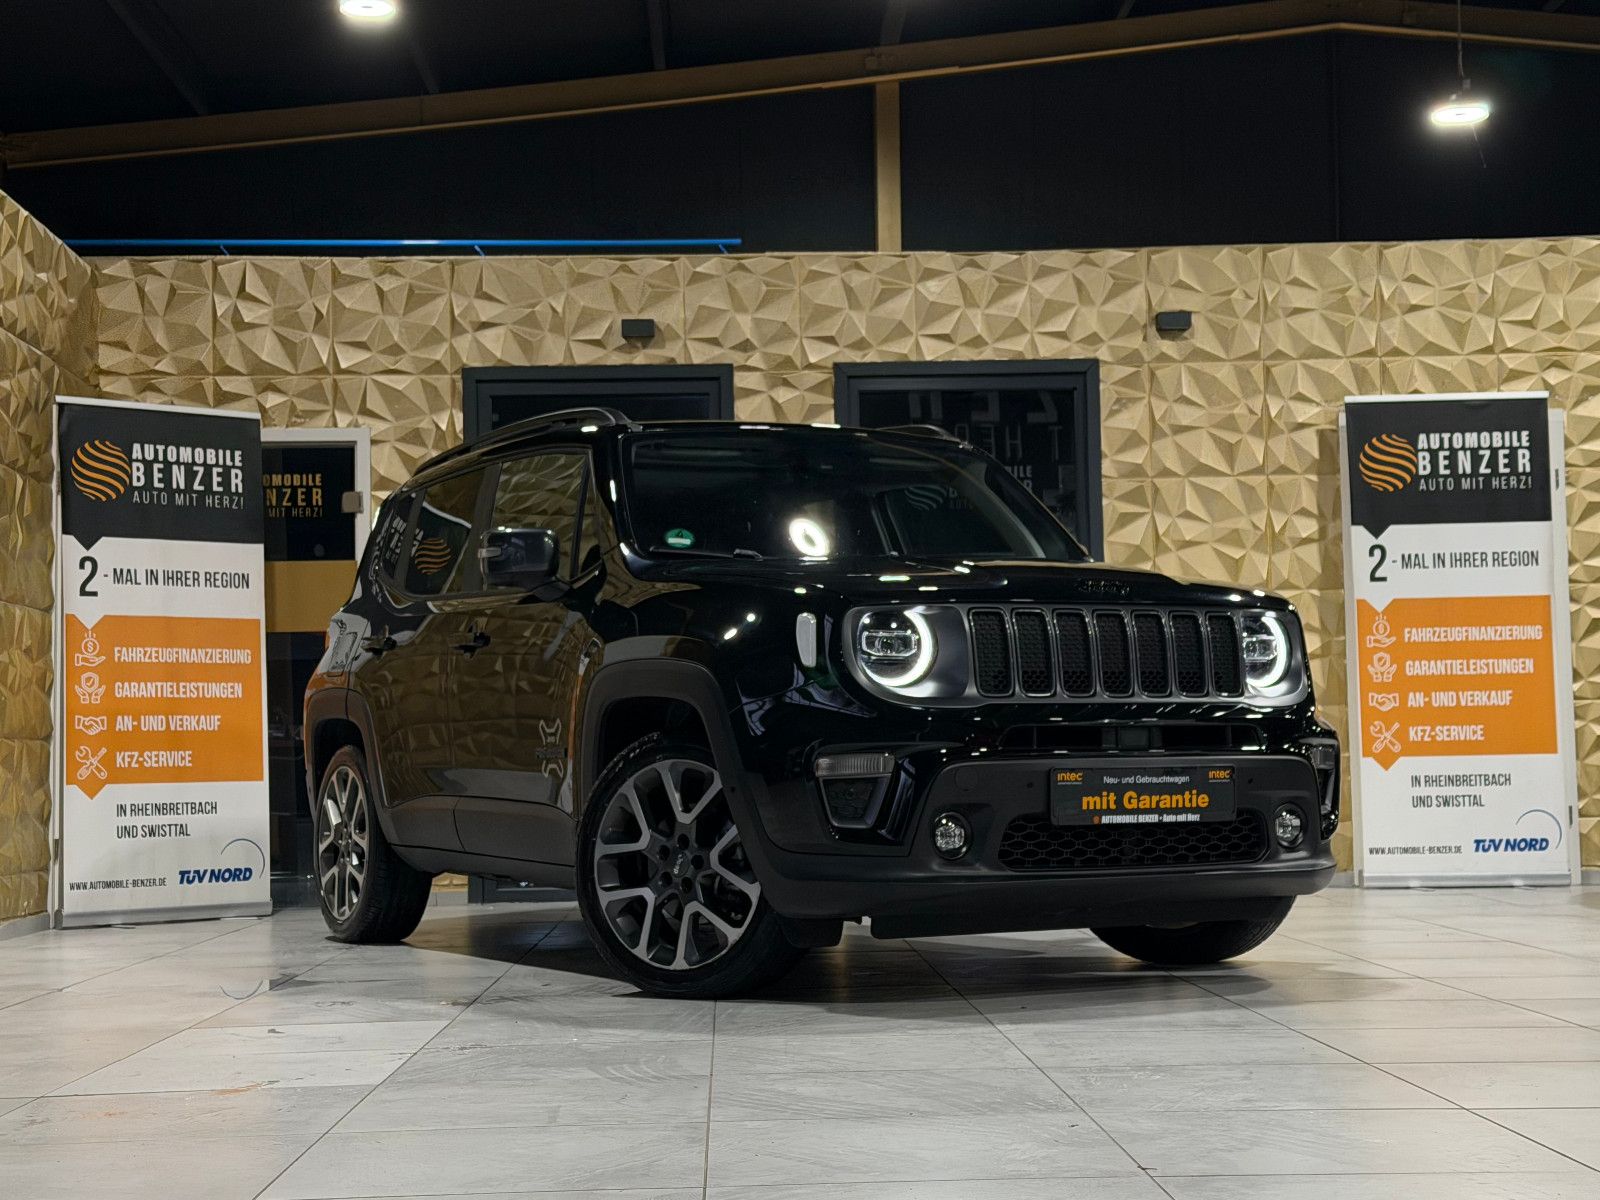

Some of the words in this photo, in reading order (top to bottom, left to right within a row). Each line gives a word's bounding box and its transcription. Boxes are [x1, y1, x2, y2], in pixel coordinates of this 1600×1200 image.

[1417, 430, 1530, 450] AUTOMOBILE
[132, 442, 243, 467] AUTOMOBILE
[1418, 449, 1531, 476] BENZER
[132, 462, 243, 494] BENZER
[1419, 477, 1454, 491] AUTO
[1461, 476, 1485, 490] MIT
[1492, 475, 1532, 490] HERZ!
[133, 492, 168, 506] AUTO
[175, 494, 197, 507] MIT
[206, 495, 244, 509] HERZ!
[1401, 553, 1429, 570] MAL
[1432, 552, 1446, 569] IN
[1450, 552, 1488, 568] IHRER
[1492, 550, 1539, 568] REGION
[112, 567, 142, 586] MAL
[145, 569, 159, 587] IN
[163, 570, 200, 588] IHRER
[204, 571, 250, 589] REGION
[1404, 625, 1543, 643] FAHRZEUGFINANZIERUNG
[114, 646, 252, 665] FAHRZEUGFINANZIERUNG
[1405, 658, 1534, 676] GARANTIELEISTUNGEN
[114, 681, 242, 699] GARANTIELEISTUNGEN
[1407, 691, 1429, 708] AN-
[1432, 690, 1457, 707] UND
[1459, 689, 1513, 707] VERKAUF
[115, 715, 138, 732] AN-
[140, 715, 166, 732] UND
[169, 715, 221, 732] VERKAUF
[1409, 725, 1485, 742] KFZ-SERVICE
[116, 750, 192, 768] KFZ-SERVICE
[1103, 776, 1120, 784] Neu-
[1122, 775, 1135, 784] und
[1136, 774, 1190, 785] Gebrauchtwagen
[1411, 775, 1422, 789] IN
[1424, 773, 1512, 788] RHEINBREITBACH
[1082, 791, 1117, 810] mit
[1123, 789, 1210, 809] Garantie
[1412, 795, 1433, 808] UND
[1435, 794, 1486, 808] SWISTTAL
[116, 803, 127, 818] IN
[130, 801, 218, 818] RHEINBREITBACH
[116, 824, 138, 839] UND
[141, 823, 191, 838] SWISTTAL
[1504, 838, 1550, 852] NORD
[208, 867, 253, 883] NORD
[69, 878, 167, 891] WWW.AUTOMOBILE-BENZER.DE
